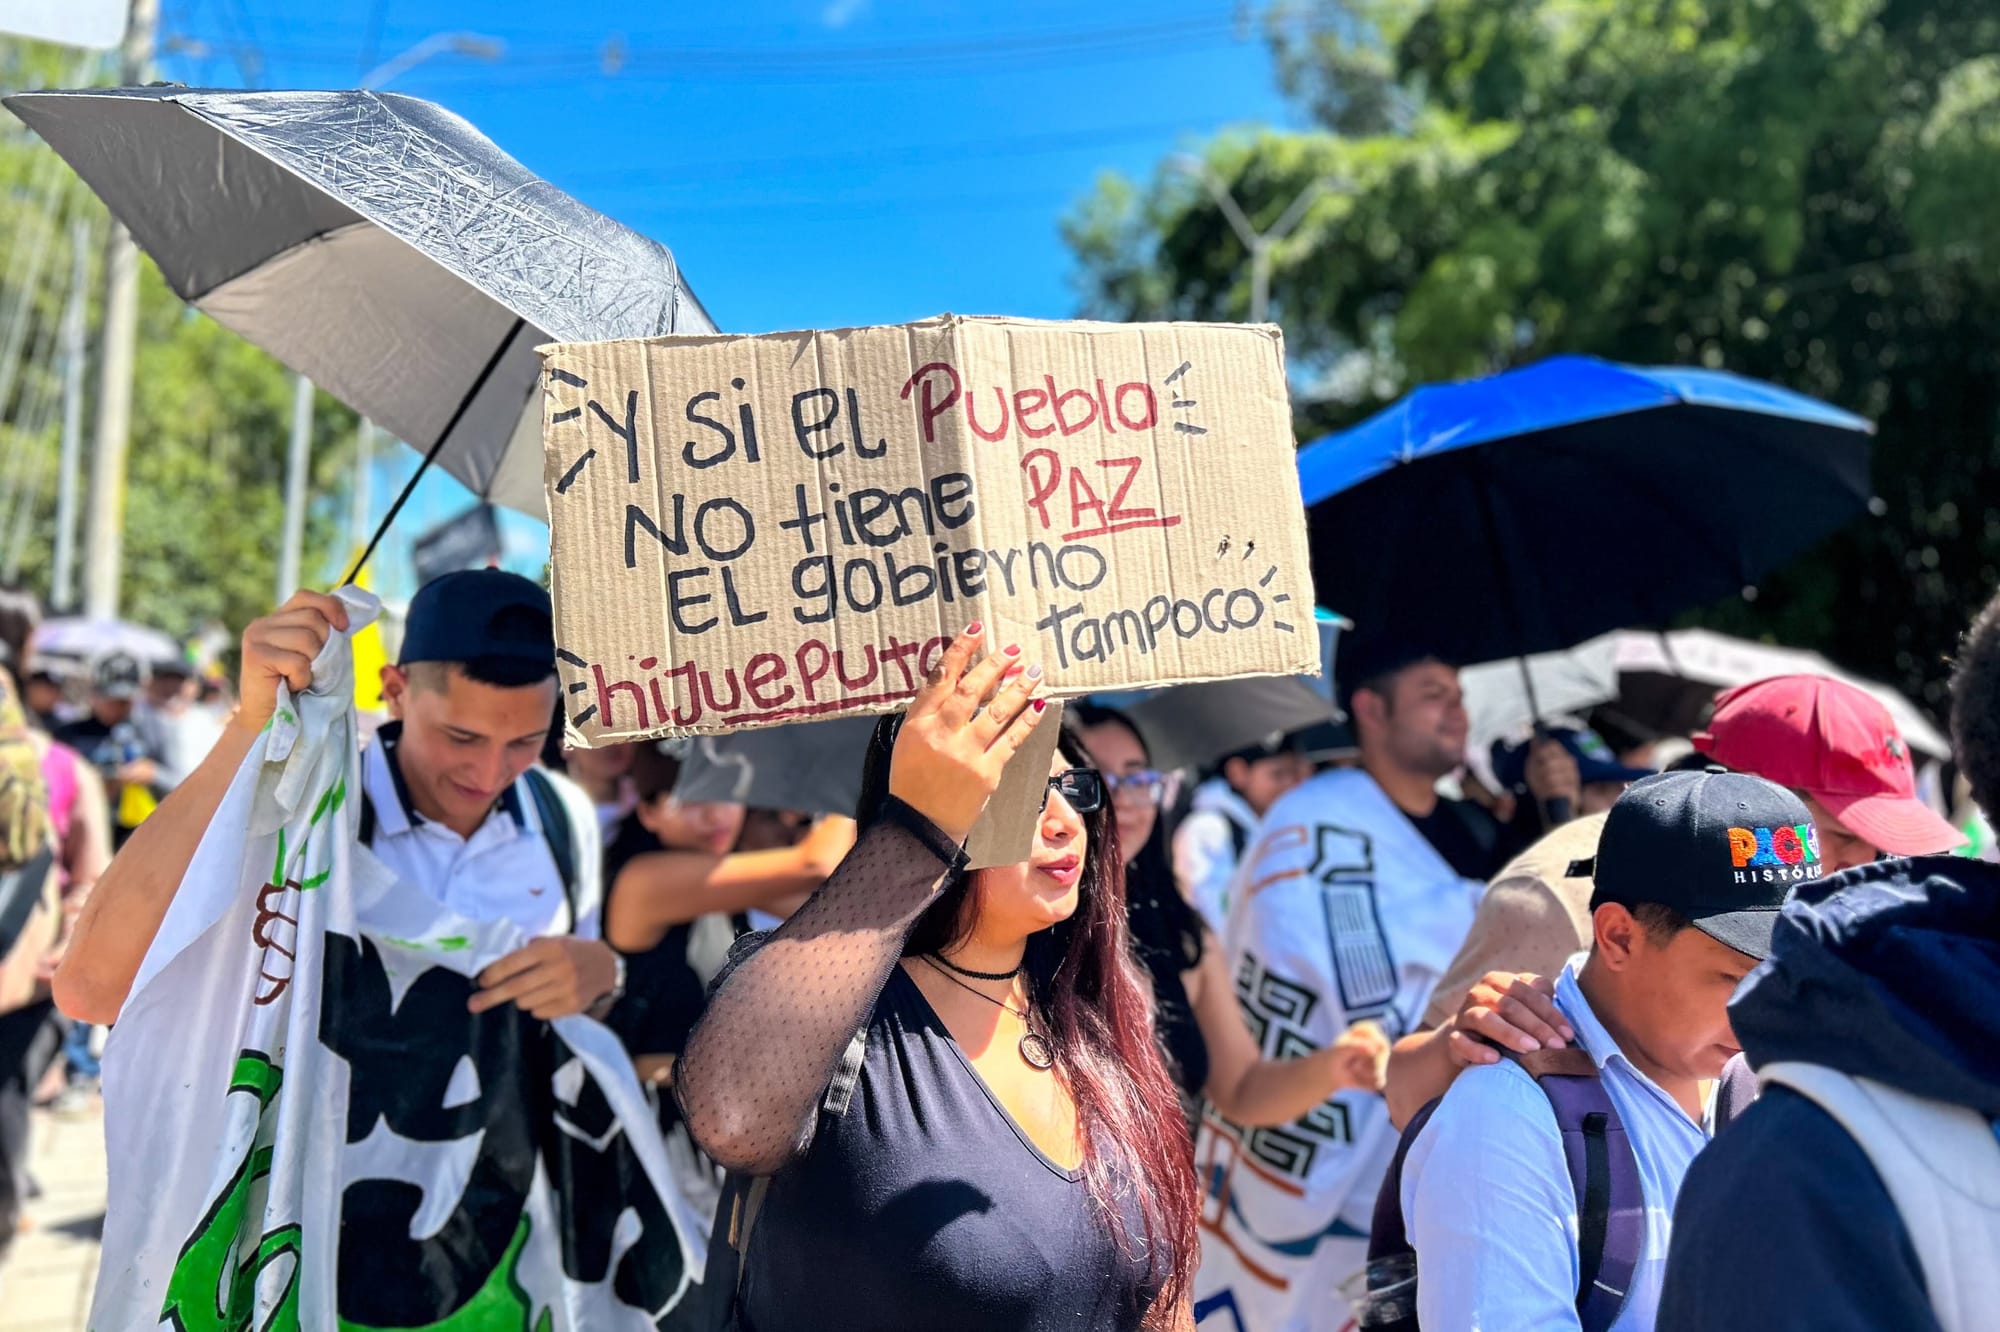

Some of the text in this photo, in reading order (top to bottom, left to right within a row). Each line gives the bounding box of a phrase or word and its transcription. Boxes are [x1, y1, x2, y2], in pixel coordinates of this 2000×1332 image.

[587, 390, 640, 484] Y
[624, 448, 1158, 569] NO tiene PAZ
[667, 541, 1108, 635] EL gobierno
